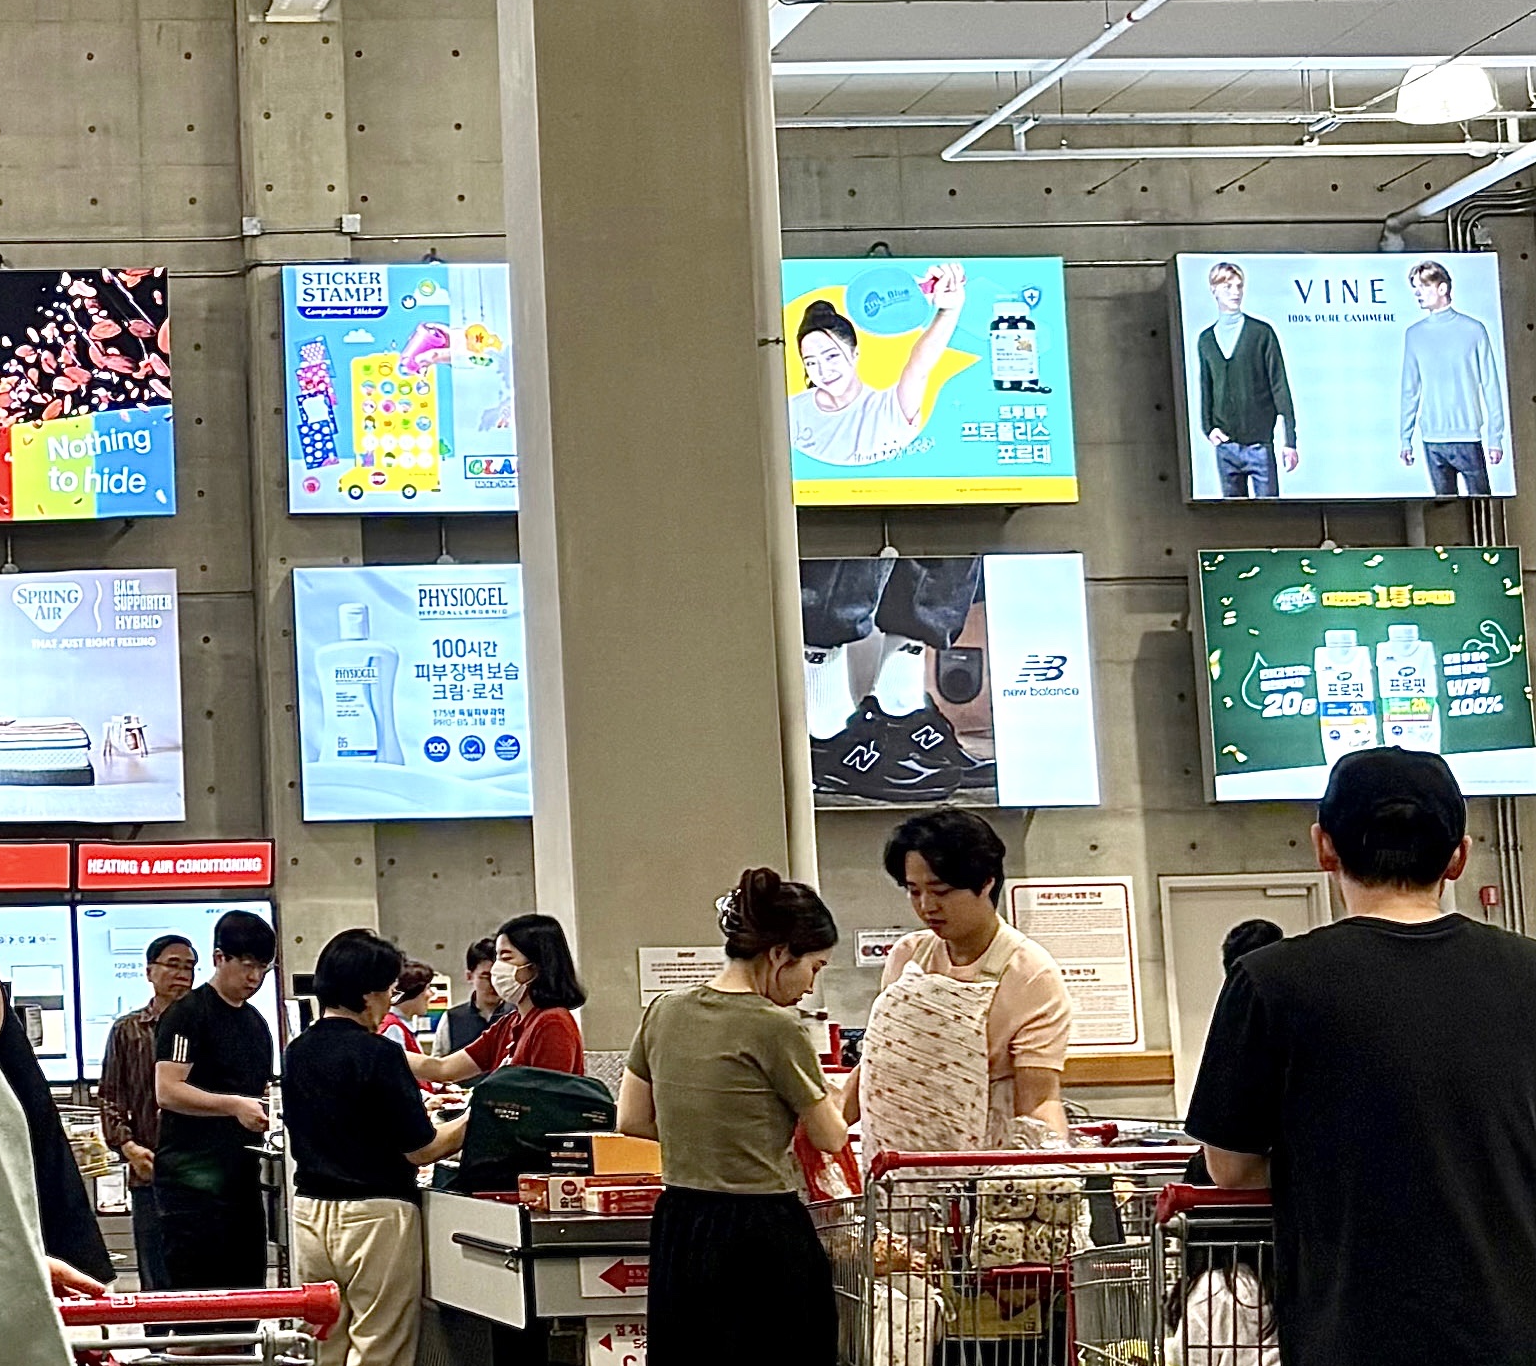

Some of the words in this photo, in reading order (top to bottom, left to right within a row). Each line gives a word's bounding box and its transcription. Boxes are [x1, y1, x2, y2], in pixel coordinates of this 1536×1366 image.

[302, 272, 381, 285] STICKER
[302, 287, 382, 302] STAMP!
[1294, 278, 1387, 304] VINE
[1288, 314, 1312, 323] 100%
[1315, 314, 1341, 323] PURE
[1344, 313, 1396, 323] CASHMERE
[961, 422, 1051, 442] 프로폴리스
[47, 427, 152, 461] Nothing
[997, 444, 1052, 465] 포르테
[48, 468, 79, 492] to
[83, 467, 147, 494] hide
[113, 579, 141, 594] BACK
[17, 588, 79, 605] SPRING
[113, 595, 172, 611] SUPPORTER
[418, 587, 508, 608] PHYSIOGEL
[34, 605, 62, 620] AIR
[418, 609, 508, 617] HYPOALLERGENIC
[115, 614, 162, 630] HYBRID
[431, 638, 498, 658] 100시간
[414, 663, 483, 682] 피부장벽
[487, 661, 520, 682] 보습
[1003, 687, 1027, 696] new
[1030, 686, 1079, 696] balance
[1327, 682, 1364, 698] 프로핏
[1390, 678, 1426, 694] 프로핏
[1448, 695, 1504, 717] 100%
[427, 742, 447, 753] 100
[87, 858, 138, 875] HEATING
[140, 860, 150, 874] &
[152, 859, 174, 875] AIR
[175, 857, 262, 875] CONDITIONING
